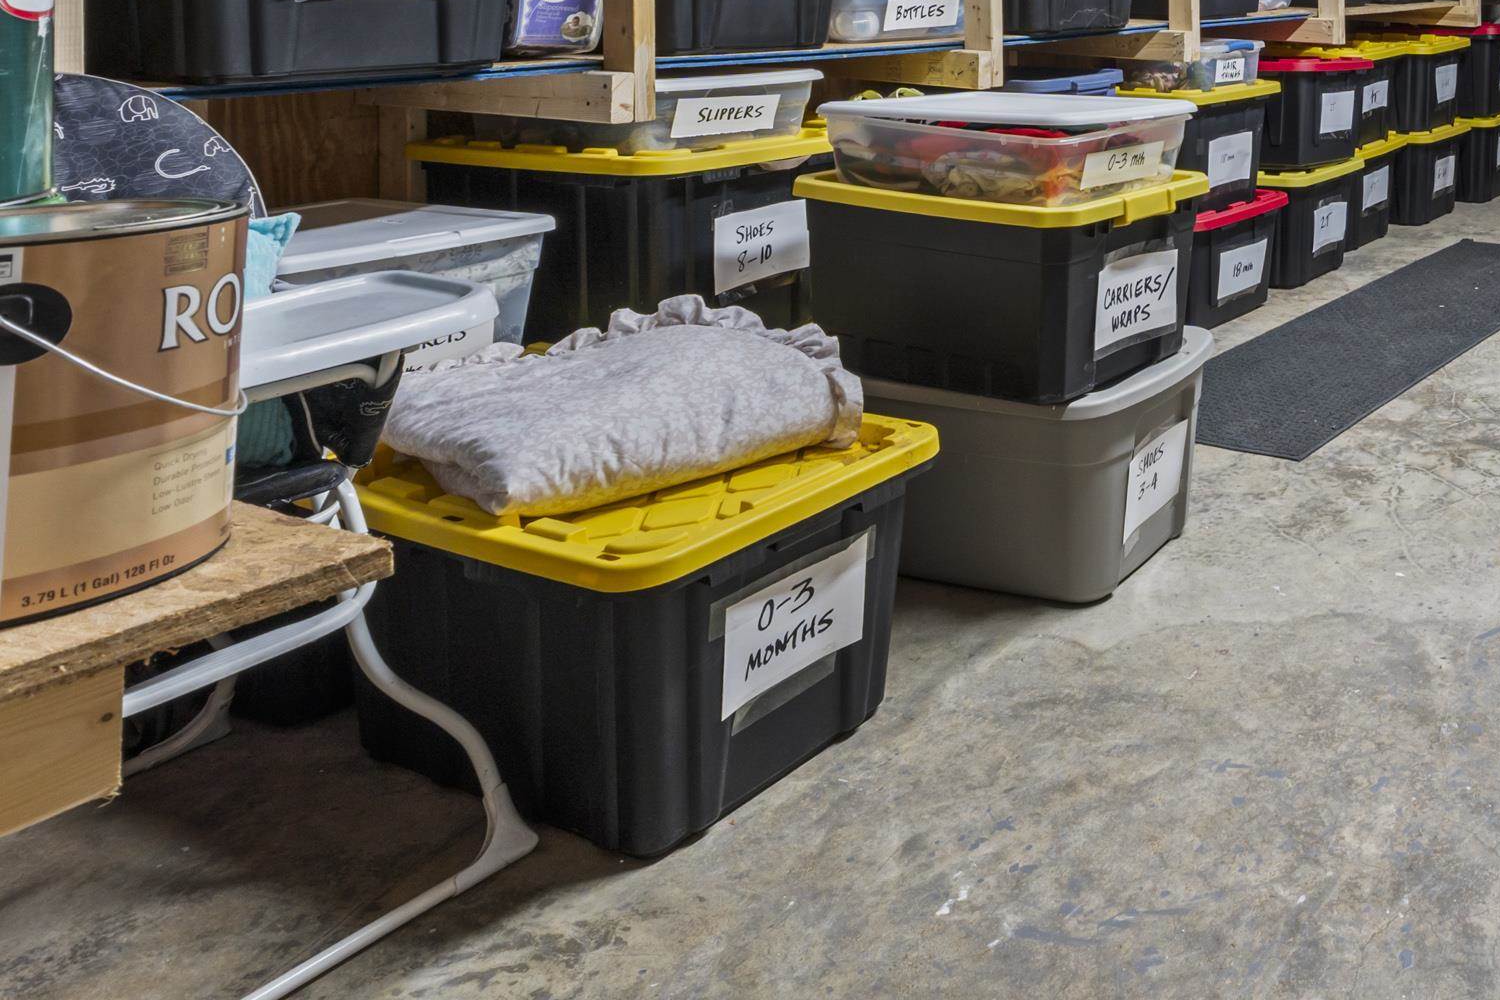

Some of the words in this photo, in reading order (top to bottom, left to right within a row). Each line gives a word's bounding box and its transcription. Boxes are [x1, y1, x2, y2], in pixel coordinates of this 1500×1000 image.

[895, 4, 945, 21] BOTTLES
[1222, 61, 1237, 70] HAIR
[697, 105, 765, 123] SLIPPERS
[1108, 152, 1128, 171] 0-3
[1129, 151, 1145, 166] mth
[736, 220, 774, 245] SHOES
[737, 244, 772, 272] 8-10
[1104, 267, 1174, 309] CARRIERS/
[1111, 303, 1151, 332] WRAPS
[1137, 441, 1165, 477] SHOES
[153, 469, 189, 486] Durable
[152, 503, 172, 515] Low
[21, 590, 55, 608] 3.79
[60, 587, 68, 598] L
[73, 582, 87, 597] (1
[92, 572, 120, 589] Gal)
[124, 564, 146, 579] 128
[163, 554, 176, 567] Oz
[758, 577, 815, 631] 0-3
[744, 608, 834, 682] MONTHS
